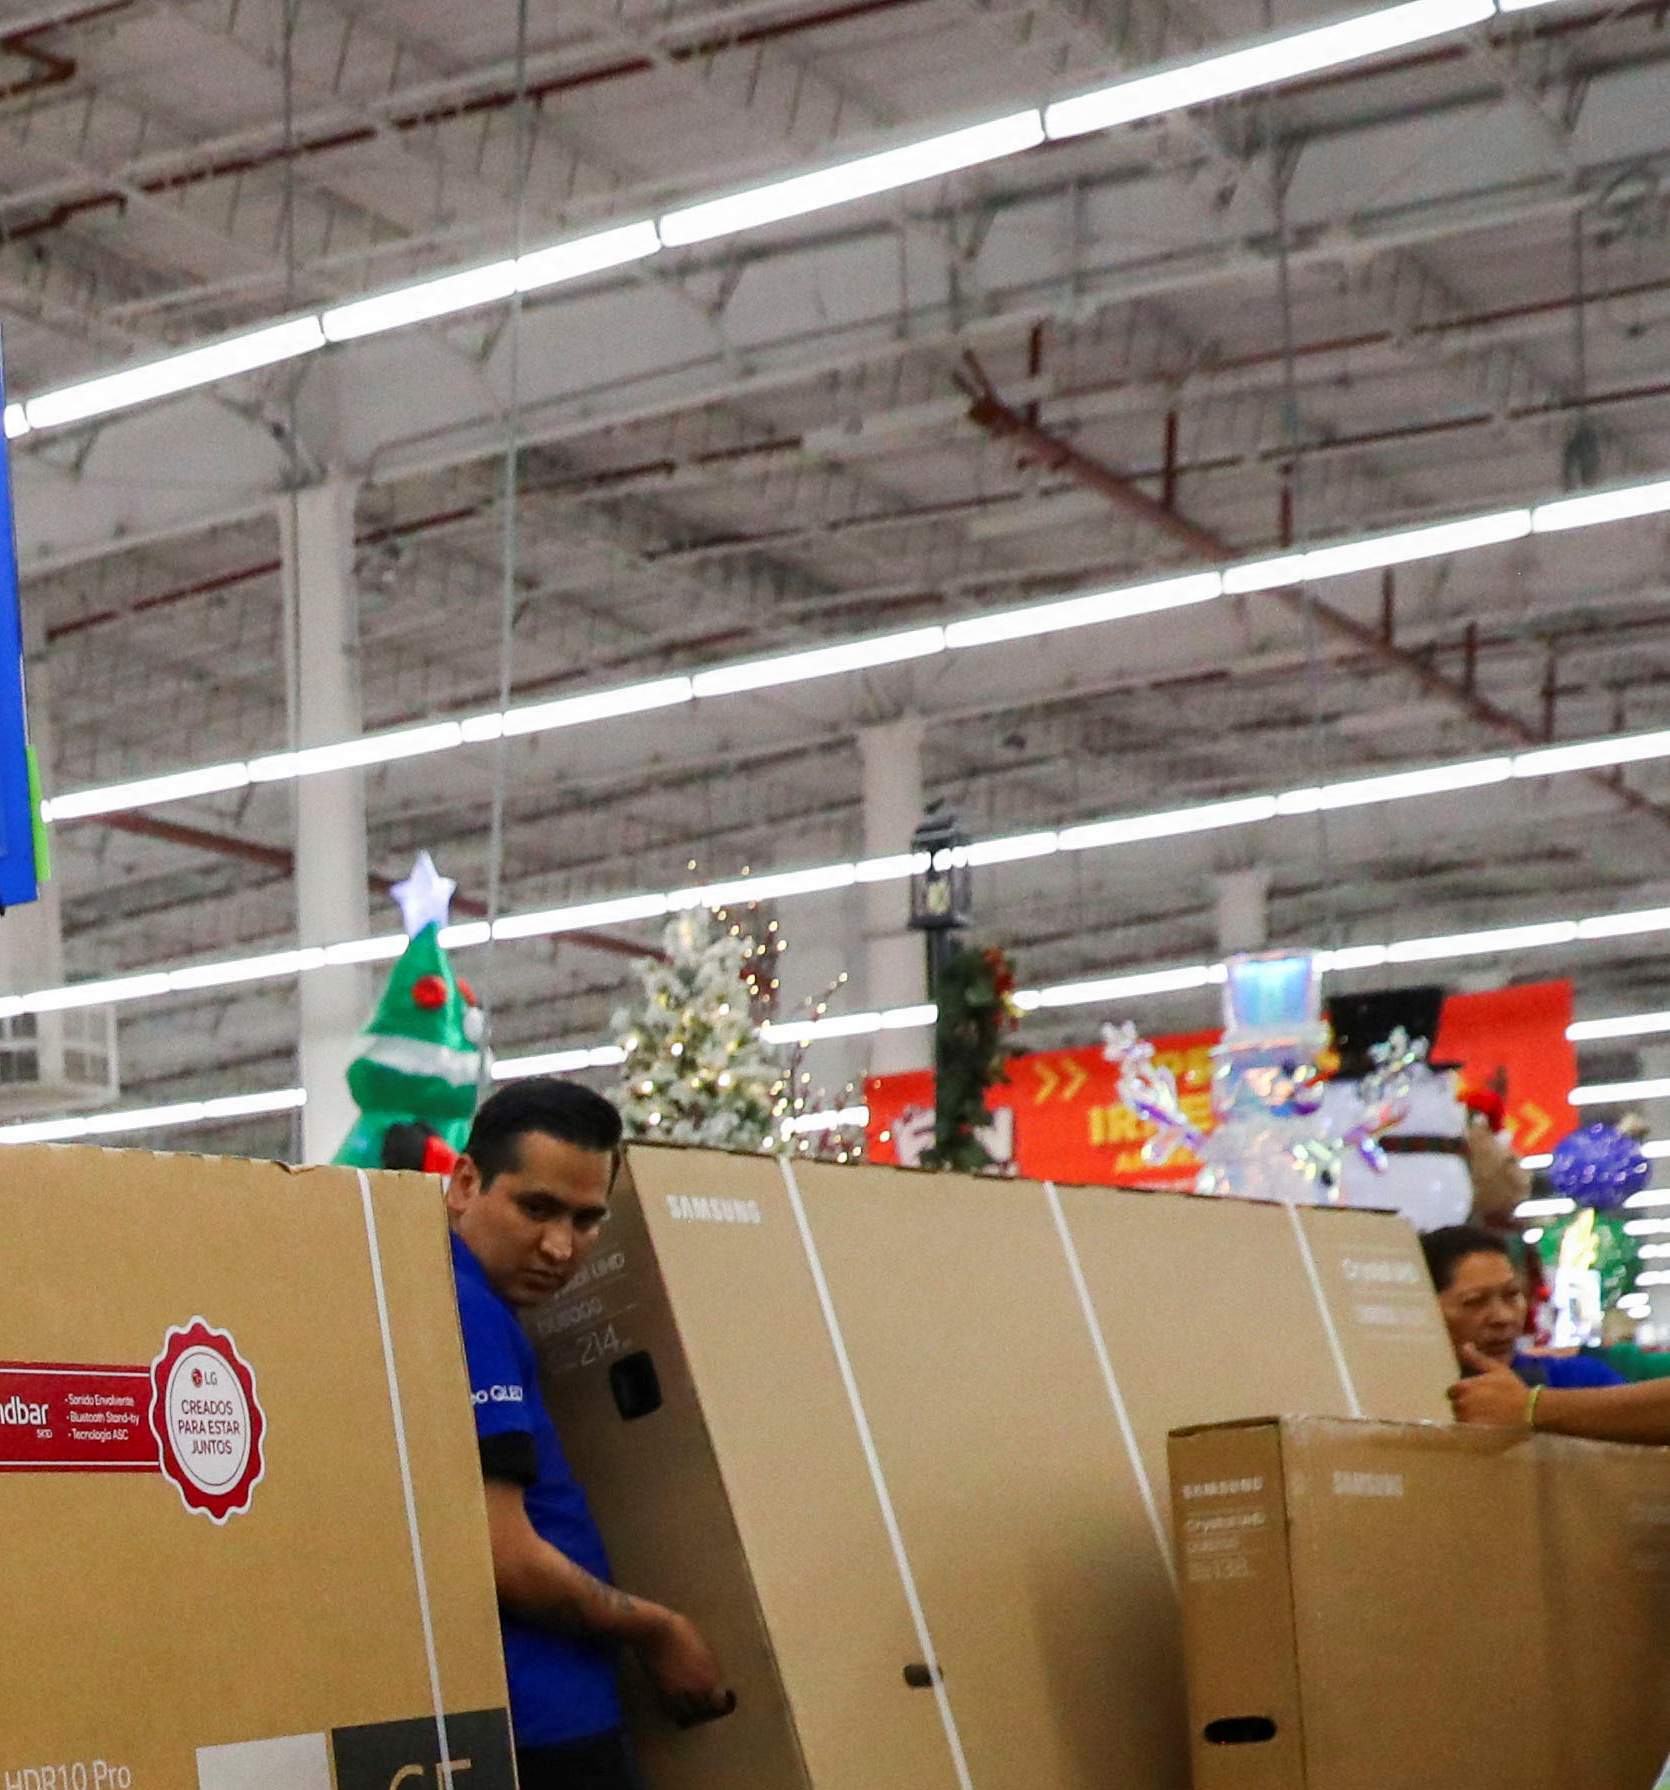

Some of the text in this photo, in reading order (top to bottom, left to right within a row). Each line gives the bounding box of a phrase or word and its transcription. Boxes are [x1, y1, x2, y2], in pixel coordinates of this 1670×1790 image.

[666, 1194, 761, 1224] SAMSUNG
[205, 1371, 218, 1386] LG
[181, 1400, 233, 1415] CREADOS
[112, 1429, 129, 1441] ASC
[178, 1419, 240, 1436] PARA ESTAR
[191, 1439, 232, 1455] JUNTOS
